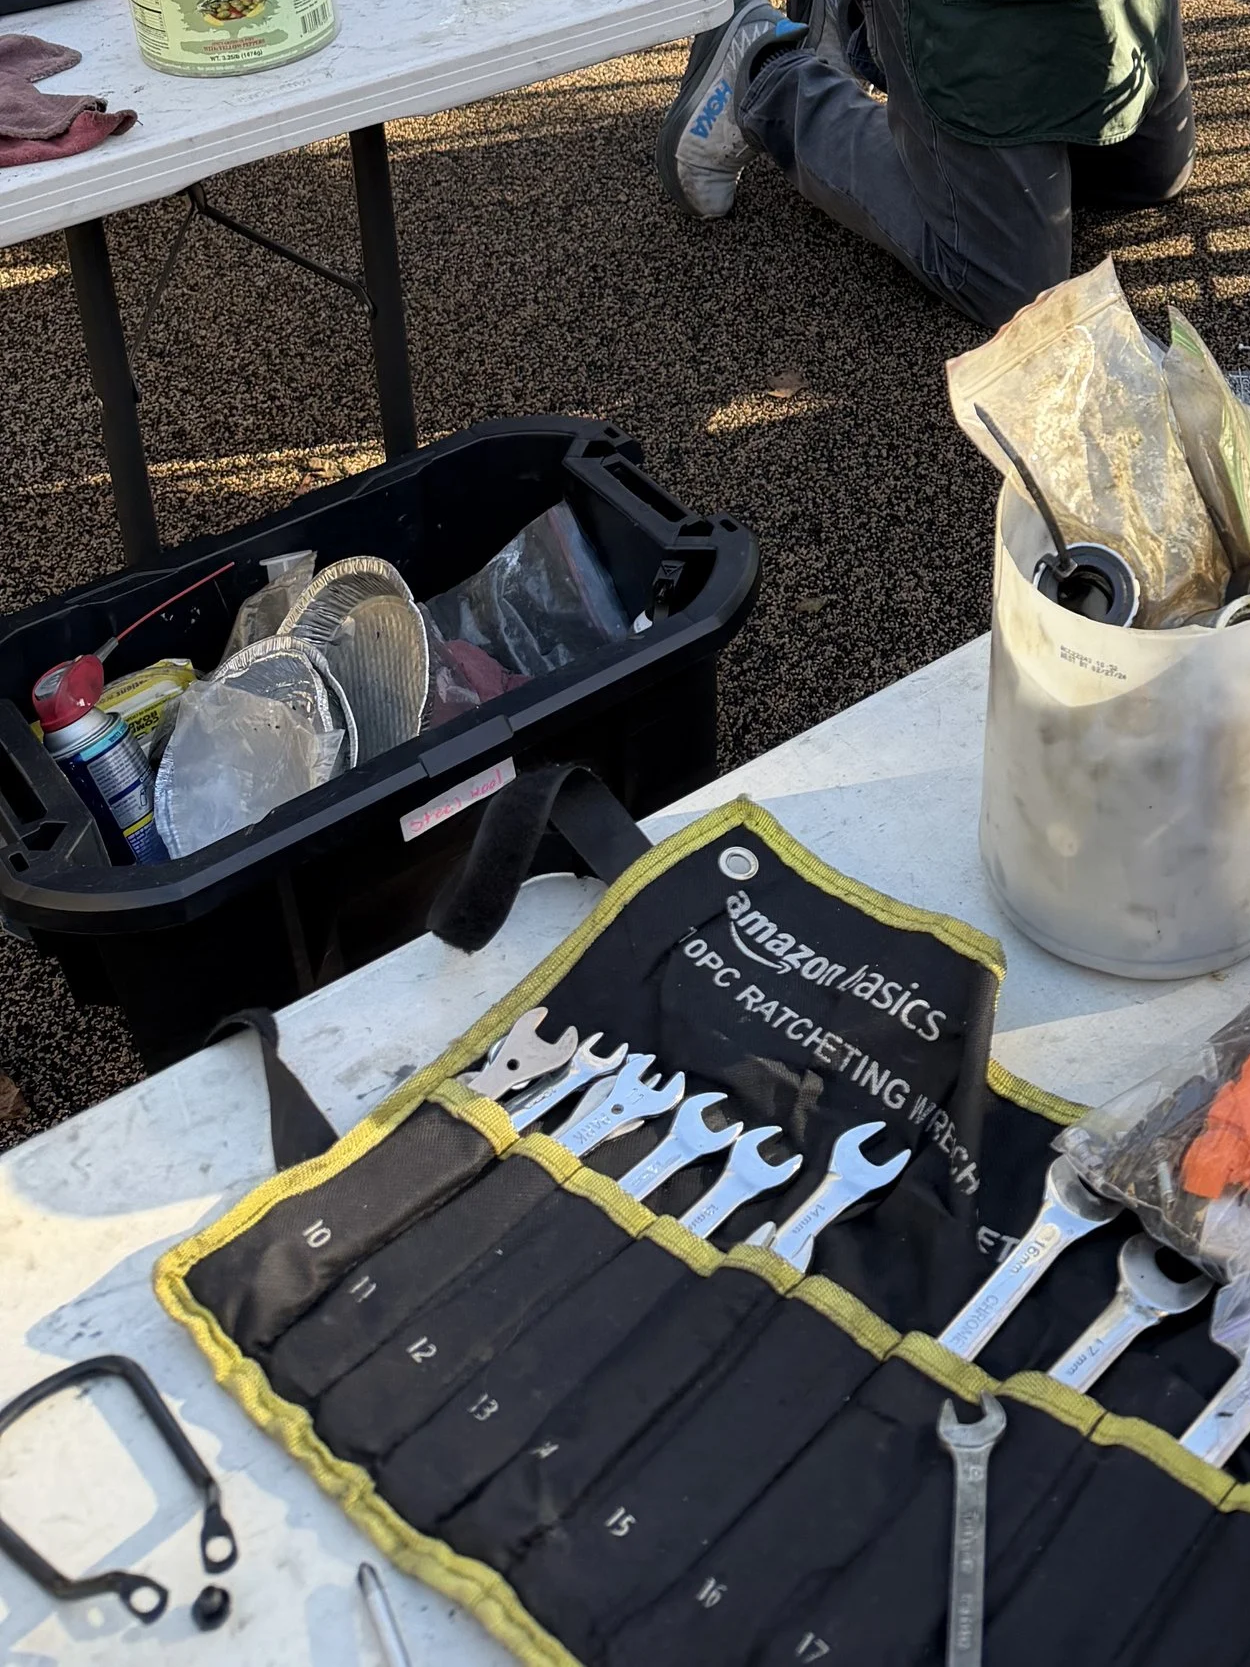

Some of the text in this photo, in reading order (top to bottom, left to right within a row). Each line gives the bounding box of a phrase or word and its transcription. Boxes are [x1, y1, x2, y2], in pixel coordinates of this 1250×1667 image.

[689, 78, 733, 139] HOKA
[735, 984, 911, 1111] RATCHETING
[303, 1219, 332, 1248] 10
[1011, 1239, 1047, 1275] 16mm
[350, 1276, 376, 1303] 11
[949, 1294, 1000, 1349] CHROME
[406, 1336, 437, 1364] 12
[467, 1392, 499, 1421] 13
[604, 1505, 637, 1537] 15
[695, 1577, 728, 1608] 16
[795, 1632, 830, 1664] 17
